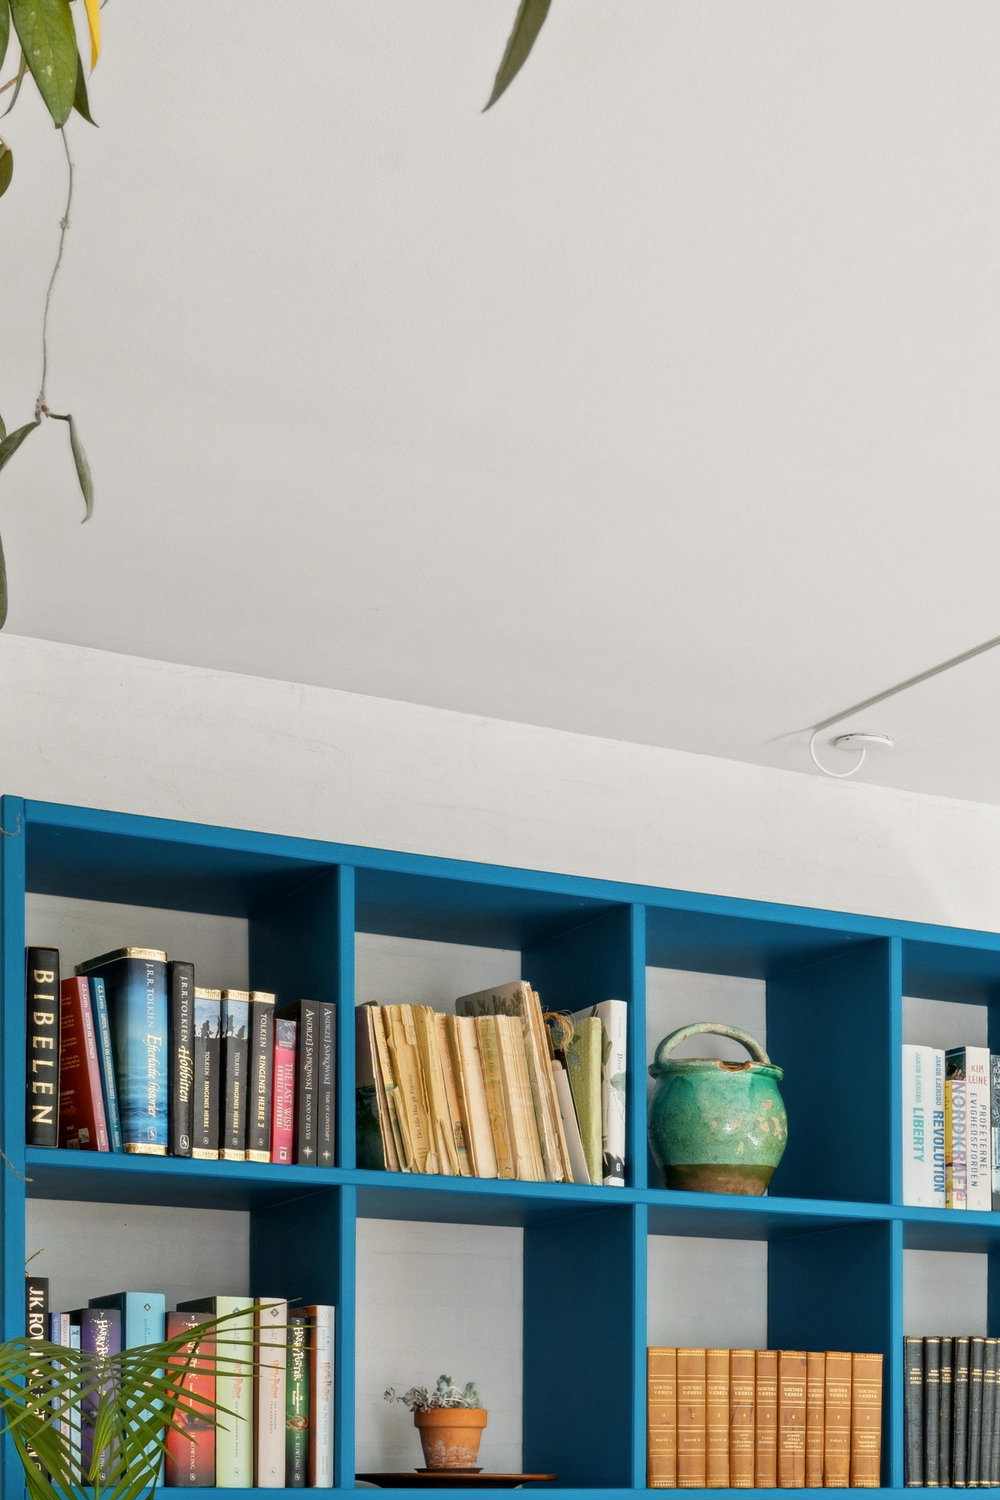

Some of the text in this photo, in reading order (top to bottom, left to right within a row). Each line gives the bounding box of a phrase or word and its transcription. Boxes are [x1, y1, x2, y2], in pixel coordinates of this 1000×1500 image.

[97, 985, 105, 994] C.S.
[145, 964, 155, 1027] J.R.R. TOLKIEN
[180, 976, 188, 999] J.R.R.
[32, 969, 55, 1124] BIBELEN
[142, 1033, 162, 1118] Efterladte historier
[178, 1046, 193, 1103] Hobbitten
[304, 1009, 314, 1090] ANDRZEJ SAPKOWSKI
[322, 1008, 332, 1085] ANDRZEJ SAPKOWSKI
[971, 1065, 984, 1073] KIM
[258, 1096, 266, 1120] HERRE
[283, 1063, 293, 1131] THE LAST WISH
[969, 1075, 987, 1085] LEINE
[913, 1107, 924, 1163] LIBERTY
[933, 1110, 945, 1192] REVOLUTION
[951, 1081, 967, 1196] NORDKRAFT
[970, 1093, 978, 1187] EVIGHEDSFJORDEN
[979, 1104, 987, 1169] PROFETERNE
[29, 1286, 44, 1311] J.K.
[93, 1319, 112, 1347] HARRY
[292, 1327, 304, 1381] HARRY POTTER
